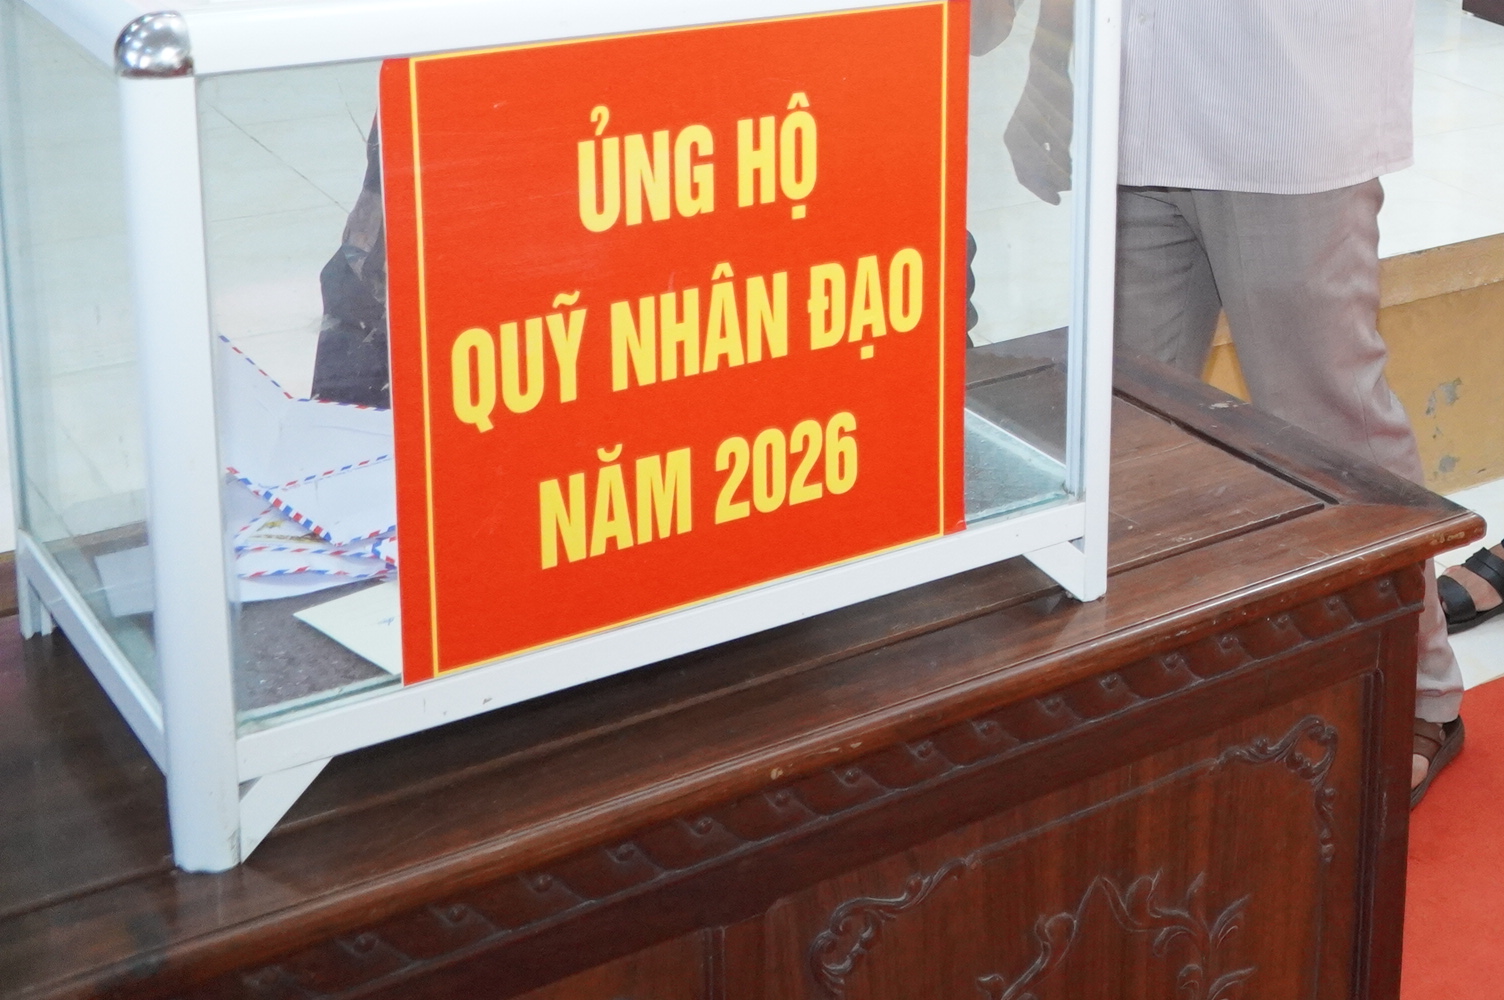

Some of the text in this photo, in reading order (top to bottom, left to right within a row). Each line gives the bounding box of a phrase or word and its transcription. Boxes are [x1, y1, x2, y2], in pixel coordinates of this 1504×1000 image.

[577, 91, 818, 233] ỦNG HỘ
[451, 247, 924, 433] QUỸ NHÂN ĐẠO
[539, 411, 858, 570] NĂM 2026
